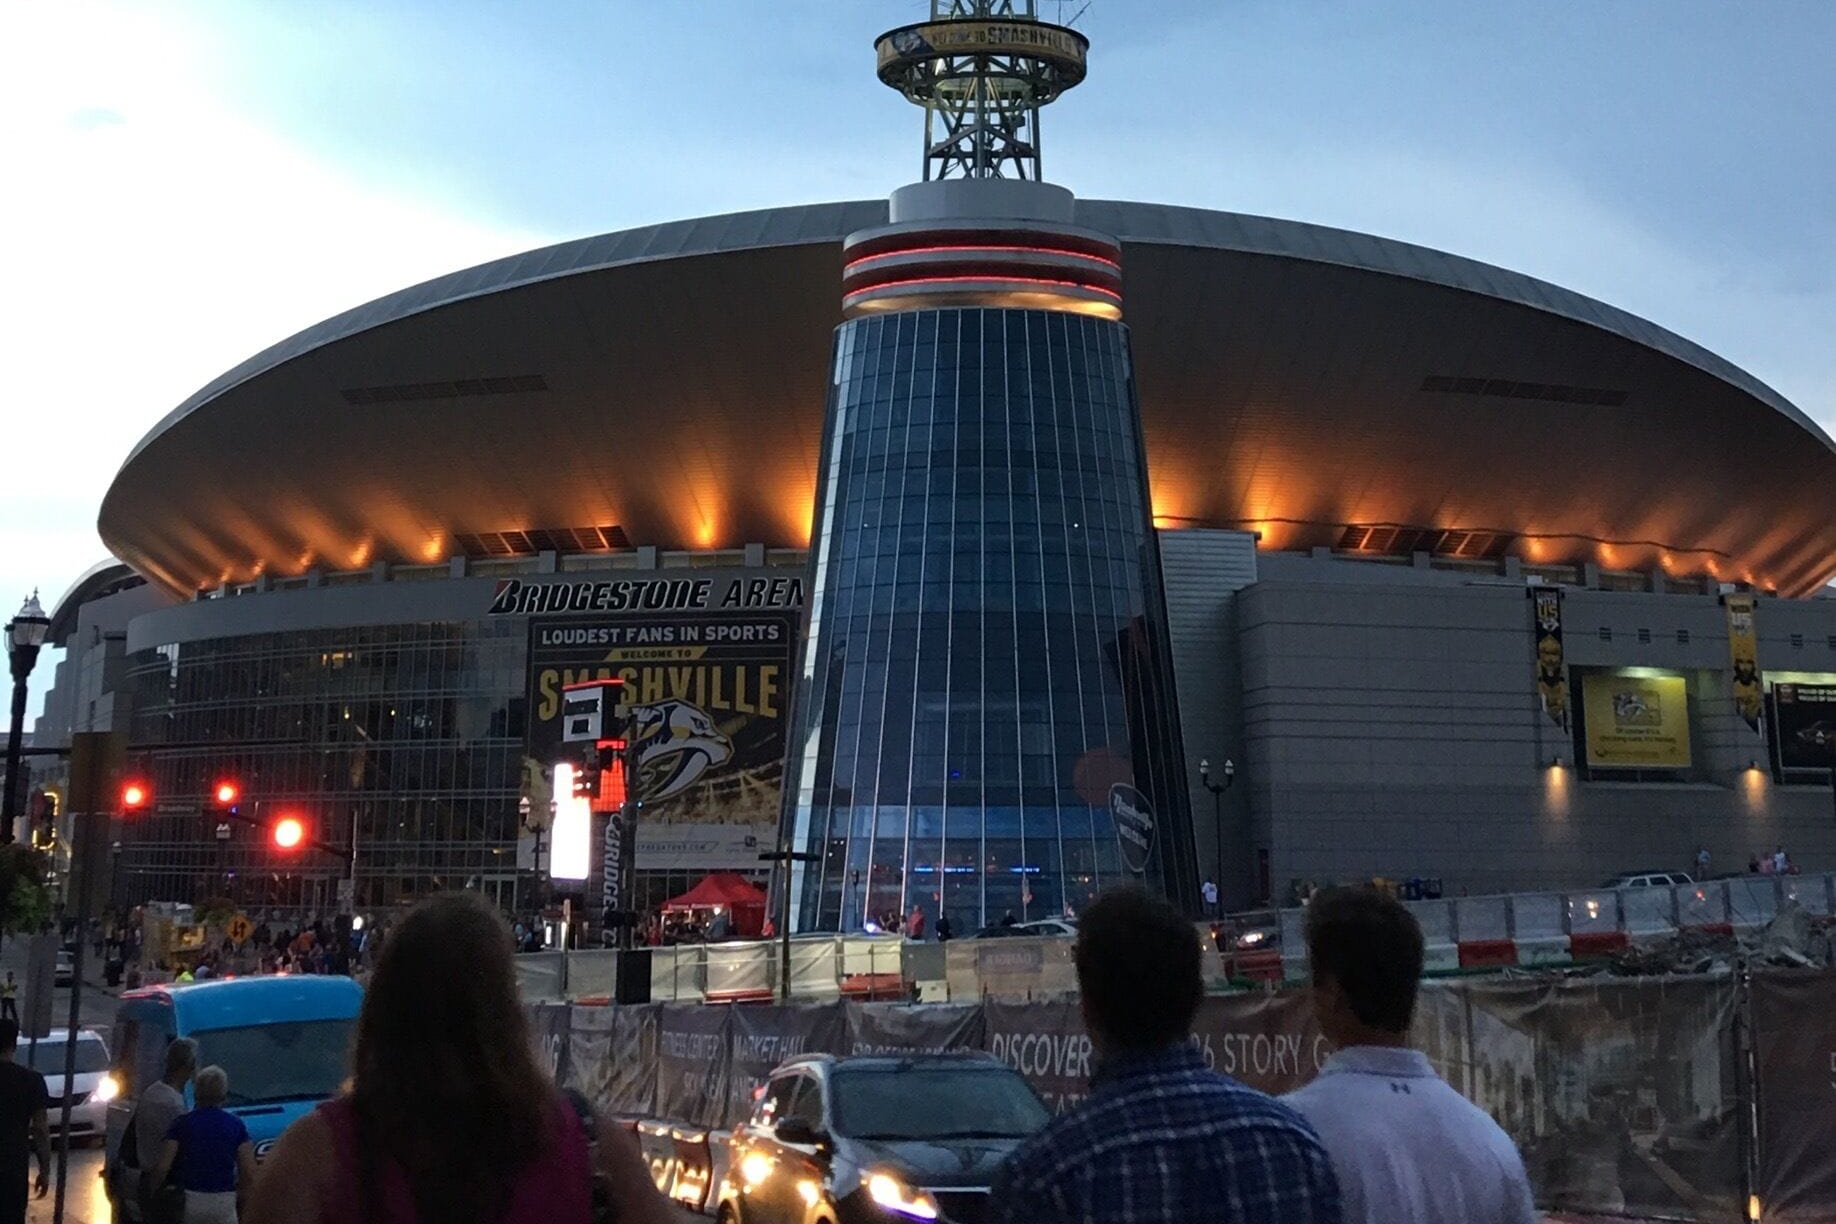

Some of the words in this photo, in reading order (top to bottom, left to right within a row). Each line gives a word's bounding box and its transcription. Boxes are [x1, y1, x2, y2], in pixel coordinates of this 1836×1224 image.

[488, 579, 713, 616] BRIDGESTONE
[541, 628, 620, 645] LOUDEST
[626, 627, 675, 642] FANS
[680, 626, 700, 641] IN
[705, 625, 780, 641] SPORTS
[620, 649, 673, 659] WELCOME
[676, 649, 692, 658] TO
[537, 665, 779, 722] SSHVILLE
[733, 1033, 780, 1062] MARKET
[992, 1032, 1093, 1077] DISCOVER
[1224, 1033, 1302, 1075] STORY
